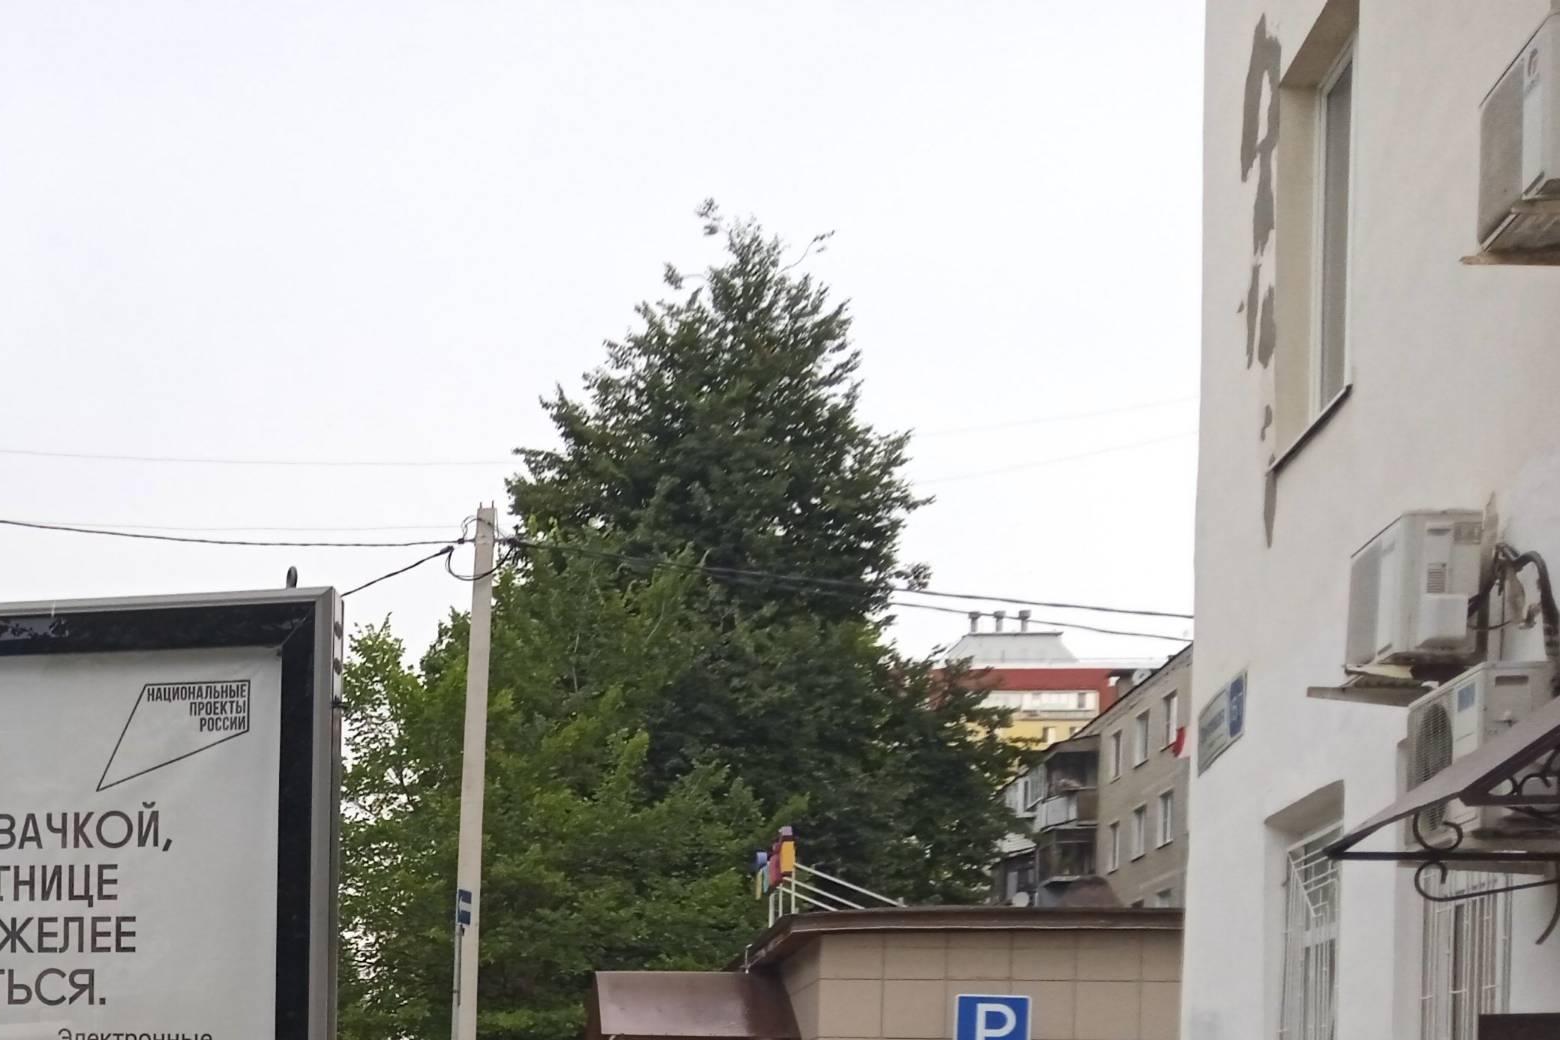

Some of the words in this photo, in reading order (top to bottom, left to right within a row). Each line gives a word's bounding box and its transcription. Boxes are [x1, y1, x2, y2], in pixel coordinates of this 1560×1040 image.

[147, 683, 247, 703] НАЦИОНАЛЬНЫЕ
[189, 700, 246, 717] ПРОЕКТЫ
[199, 715, 246, 732] РОССИИ
